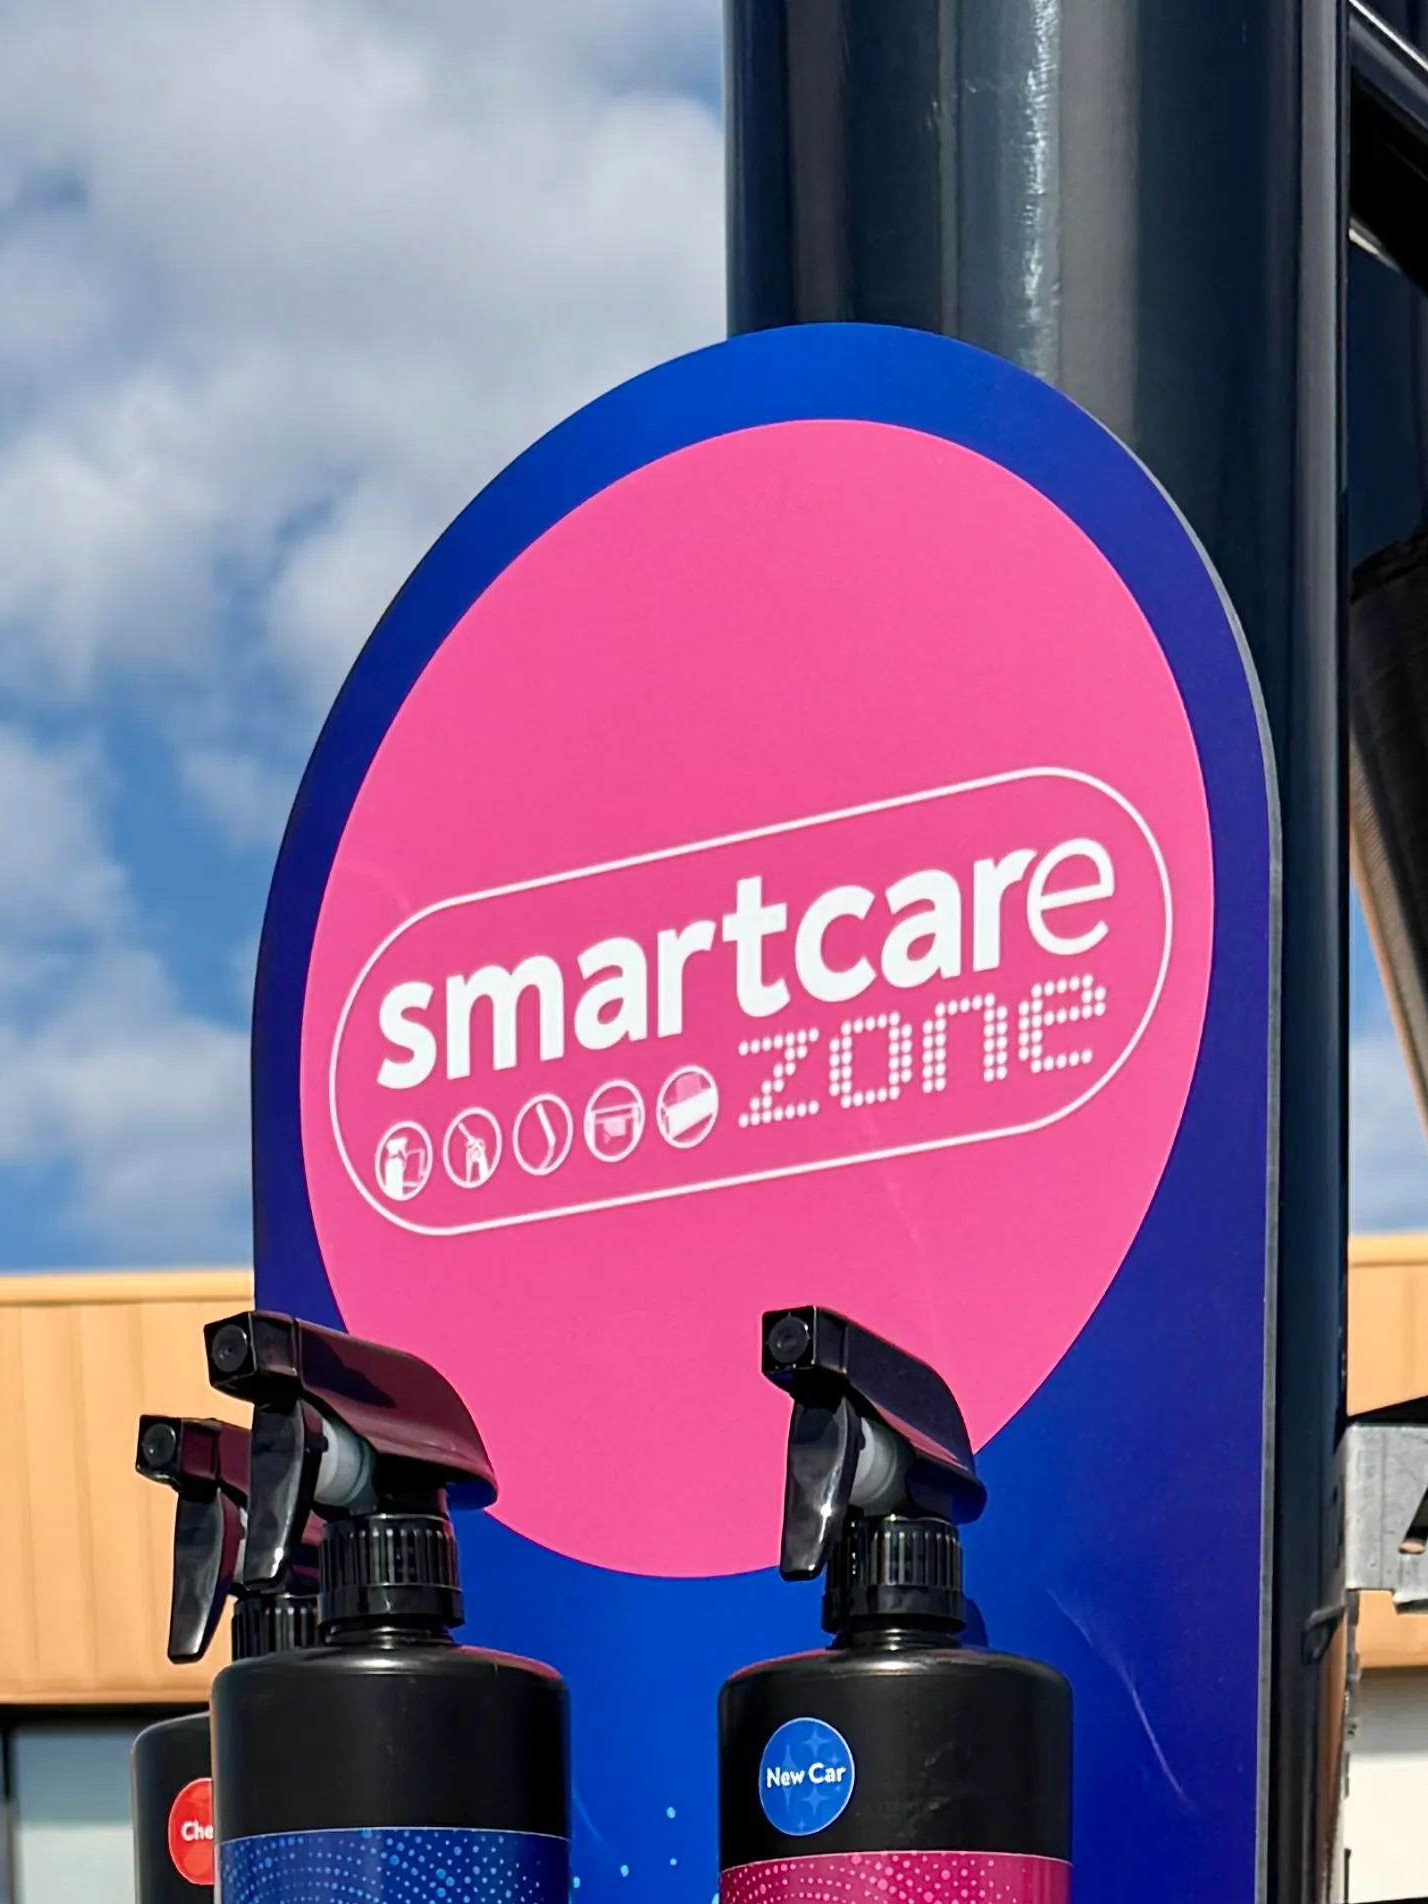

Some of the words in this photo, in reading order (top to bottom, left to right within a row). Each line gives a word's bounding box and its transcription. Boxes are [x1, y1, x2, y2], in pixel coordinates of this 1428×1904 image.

[376, 837, 1116, 1092] smartcare
[737, 973, 1106, 1129] zone
[766, 1766, 805, 1789] New
[808, 1762, 847, 1784] Car
